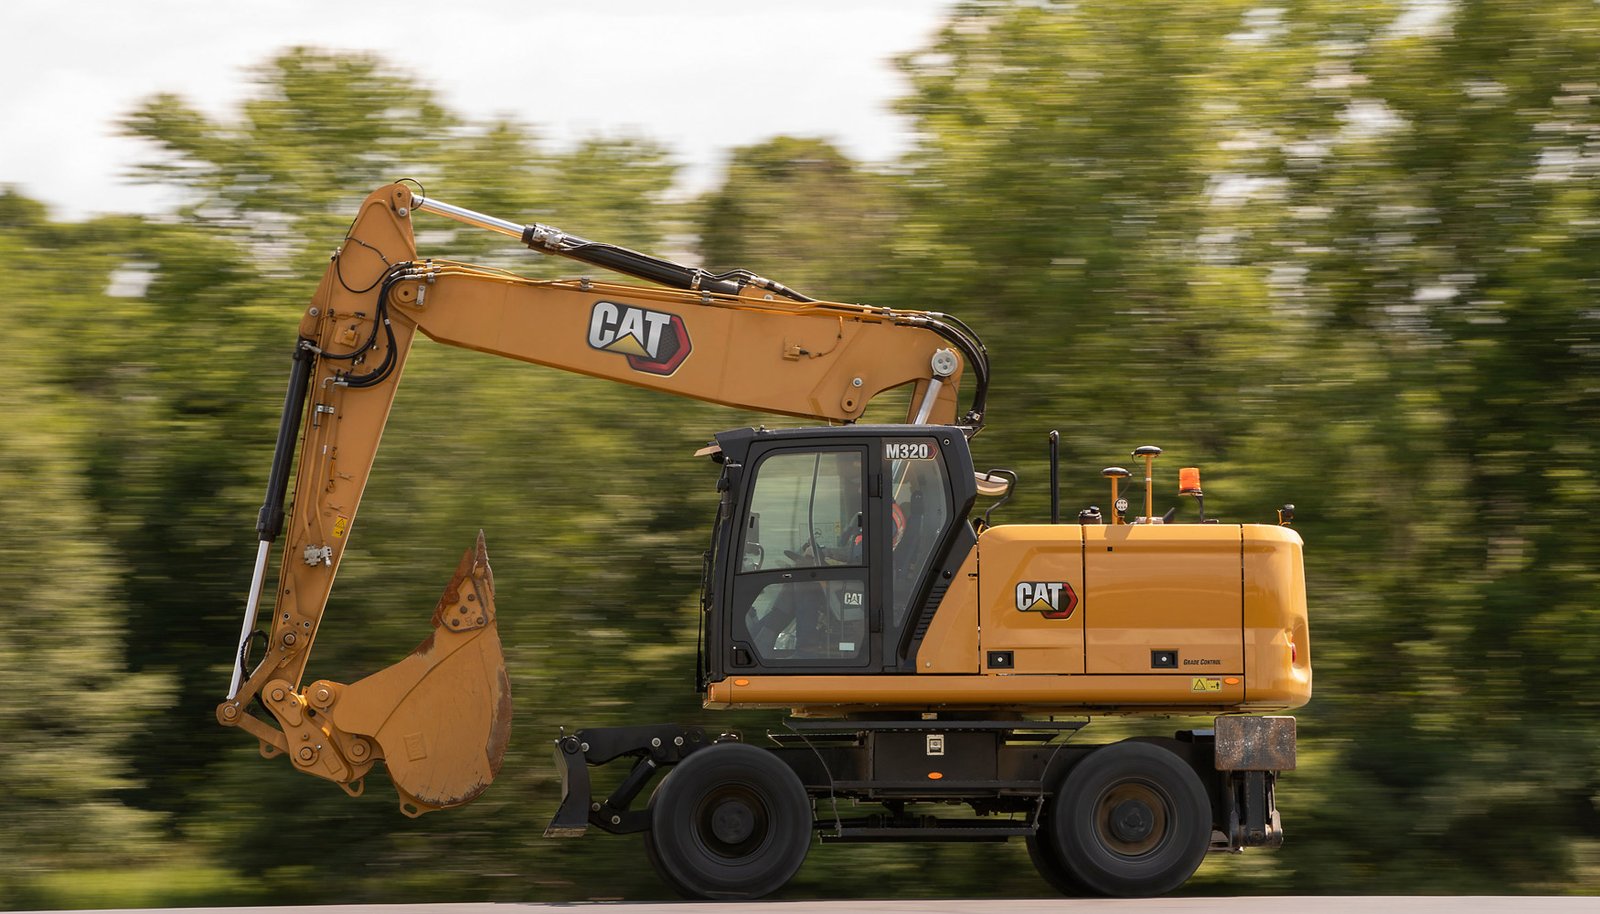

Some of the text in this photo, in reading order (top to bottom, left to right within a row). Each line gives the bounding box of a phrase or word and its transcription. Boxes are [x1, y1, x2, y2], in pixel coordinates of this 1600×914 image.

[589, 302, 671, 359] CAT
[886, 444, 928, 459] M320
[844, 592, 863, 605] CAT
[1016, 582, 1063, 611] CAT
